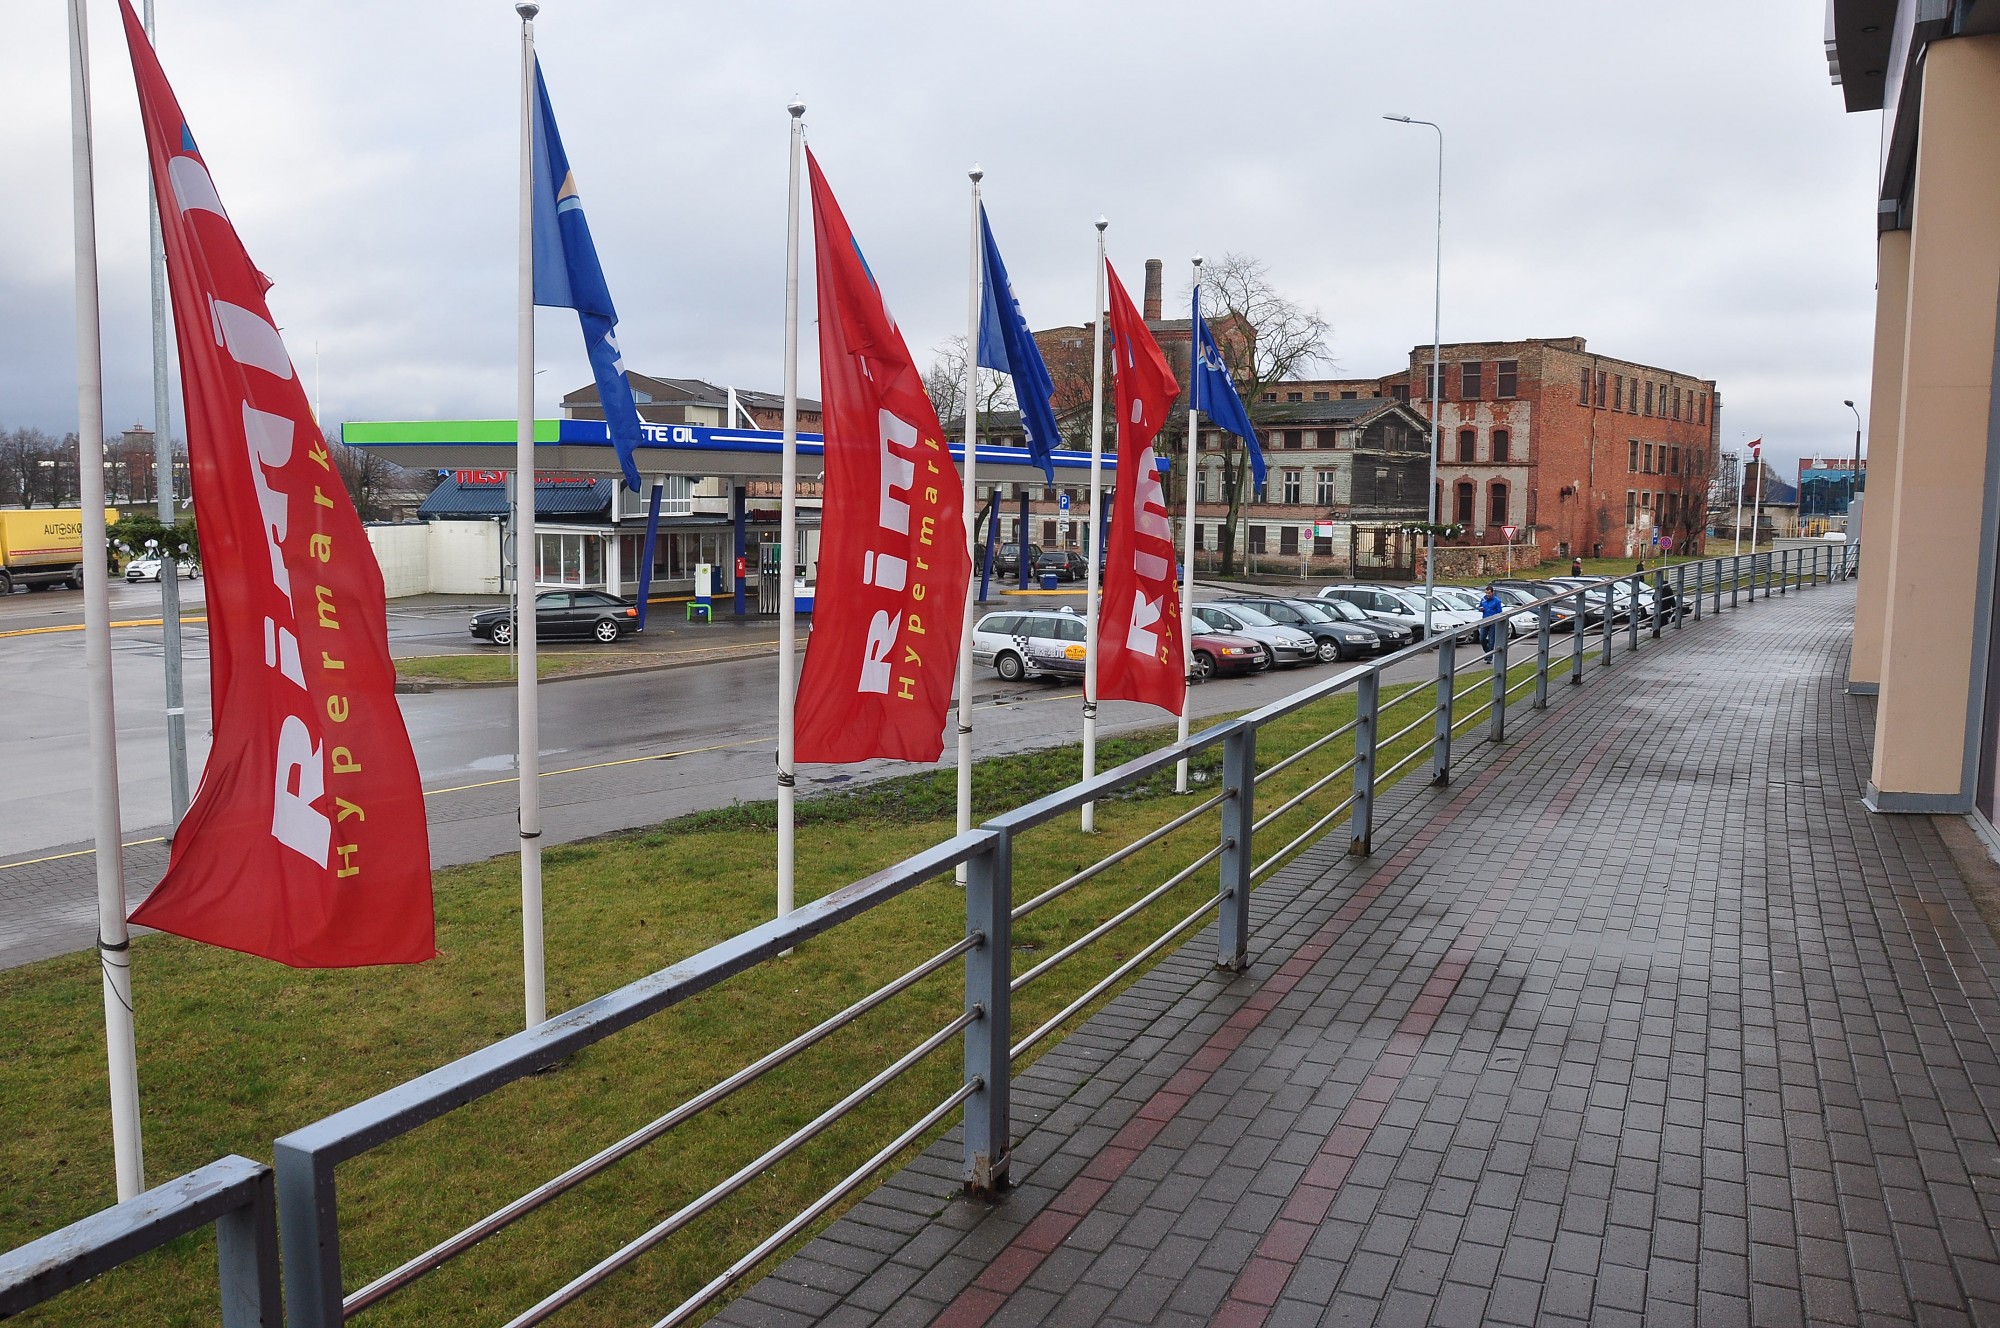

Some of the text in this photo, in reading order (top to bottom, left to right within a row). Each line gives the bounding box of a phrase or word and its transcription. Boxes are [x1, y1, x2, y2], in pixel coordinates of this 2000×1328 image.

[673, 427, 698, 443] OIL
[899, 438, 942, 700] Hypermark
[1159, 577, 1180, 665] Hype
[308, 438, 361, 879] Hypermark
